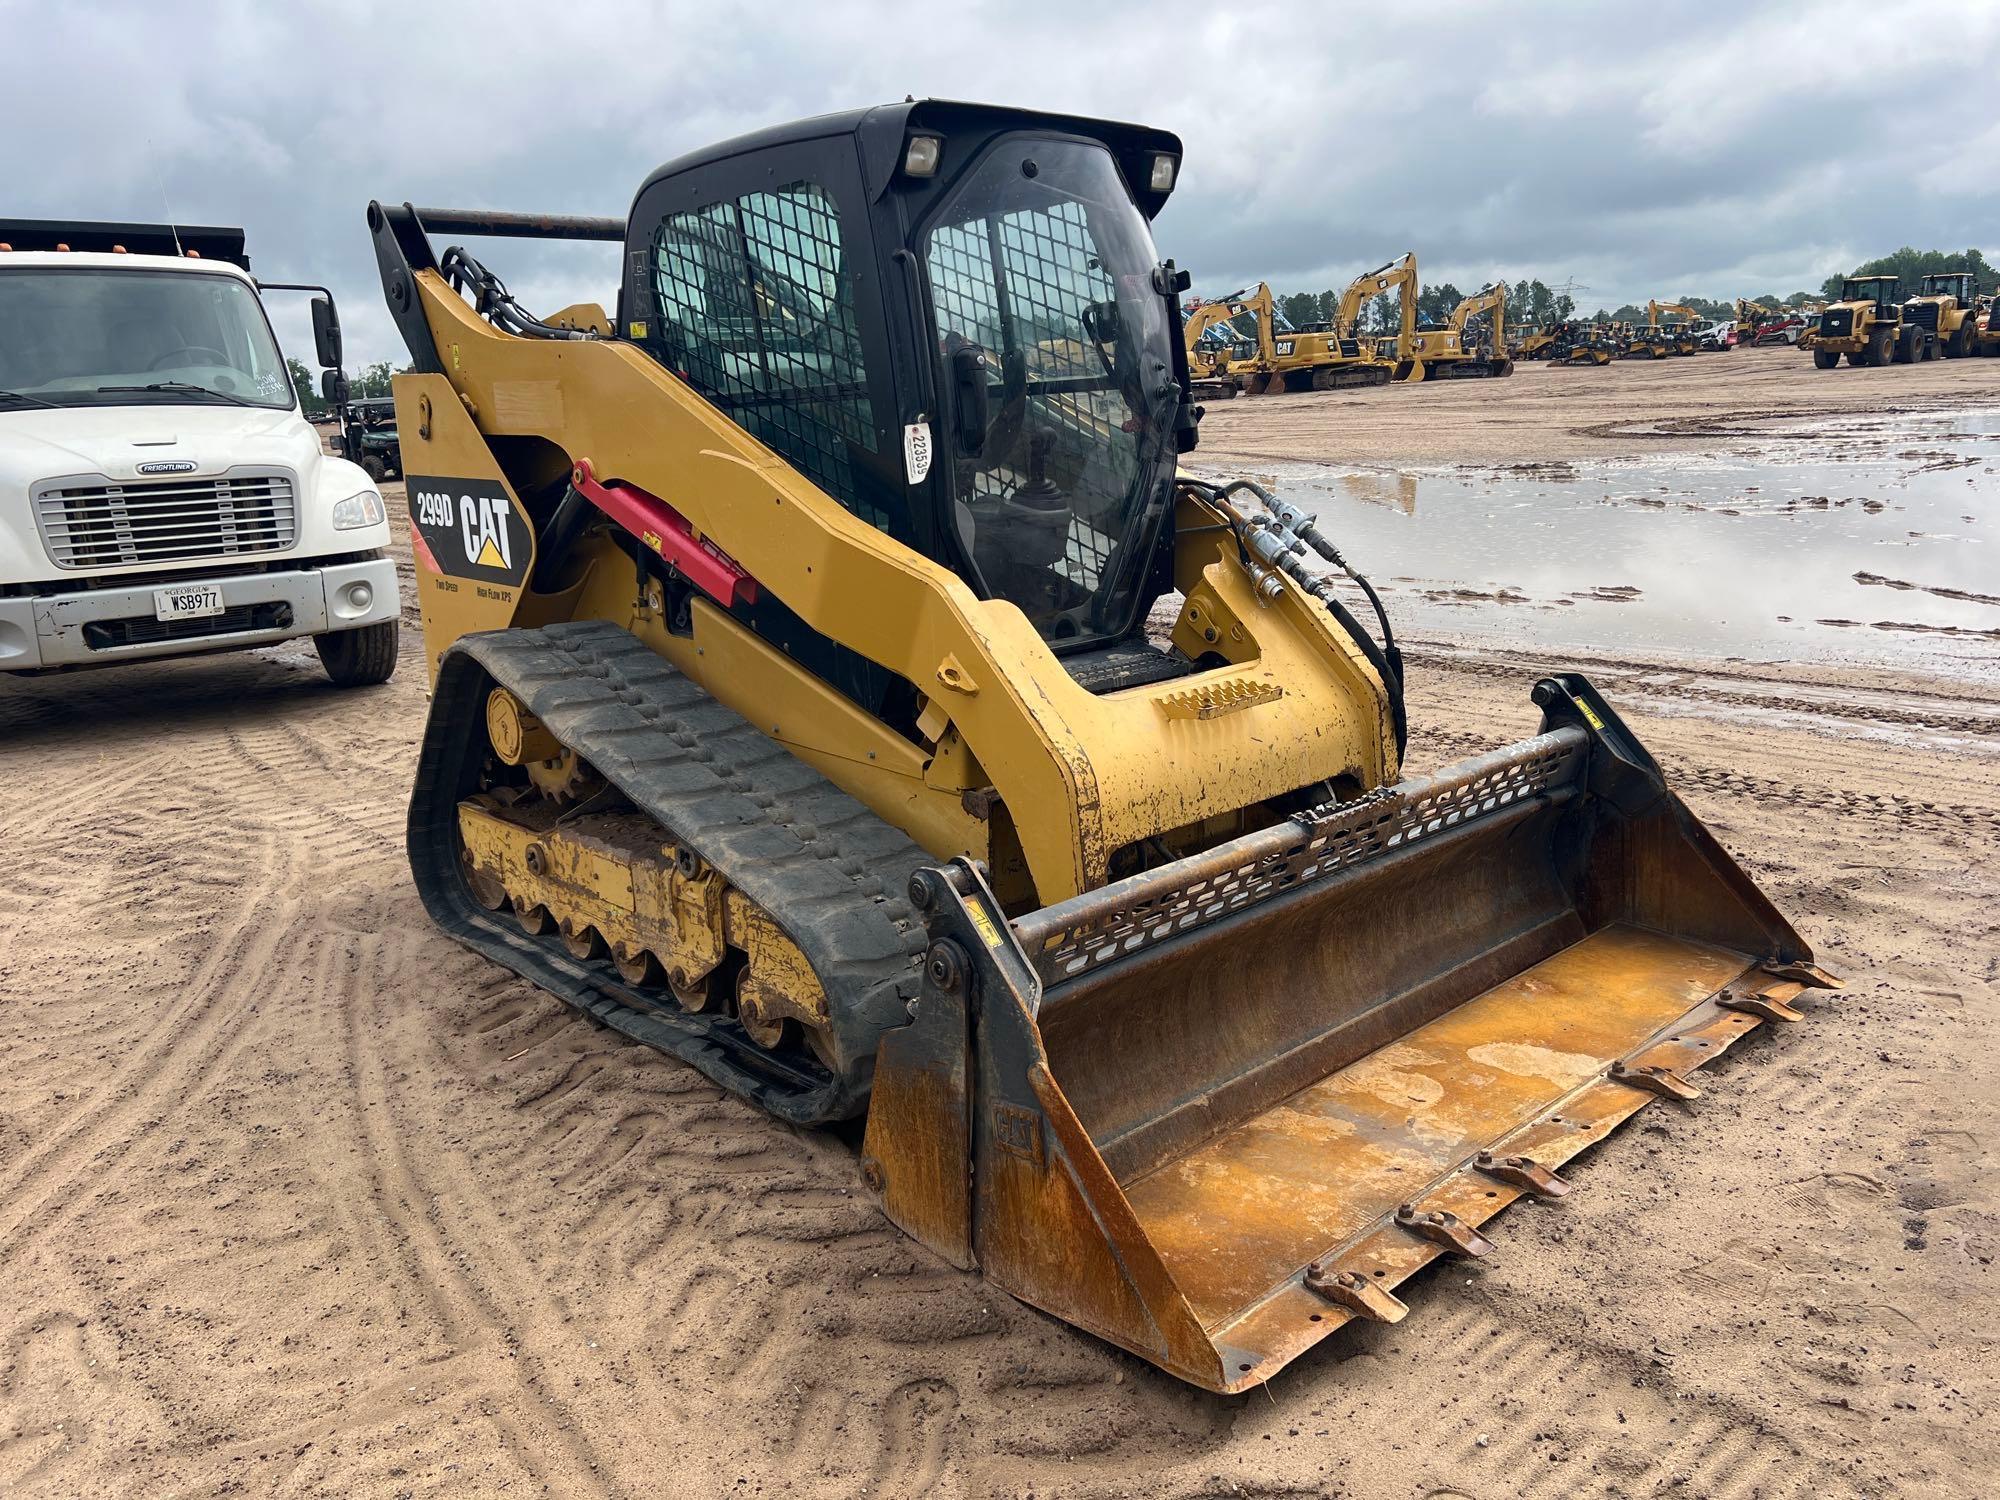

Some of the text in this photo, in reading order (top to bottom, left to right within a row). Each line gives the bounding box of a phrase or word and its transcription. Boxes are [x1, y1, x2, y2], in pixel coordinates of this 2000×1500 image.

[1277, 342, 1292, 355] CAT
[913, 435, 928, 475] 223539
[143, 464, 191, 472] FREIGHTLINER
[417, 492, 512, 570] 299D CAT
[170, 586, 207, 595] GEORGIA
[171, 592, 217, 611] WSB977
